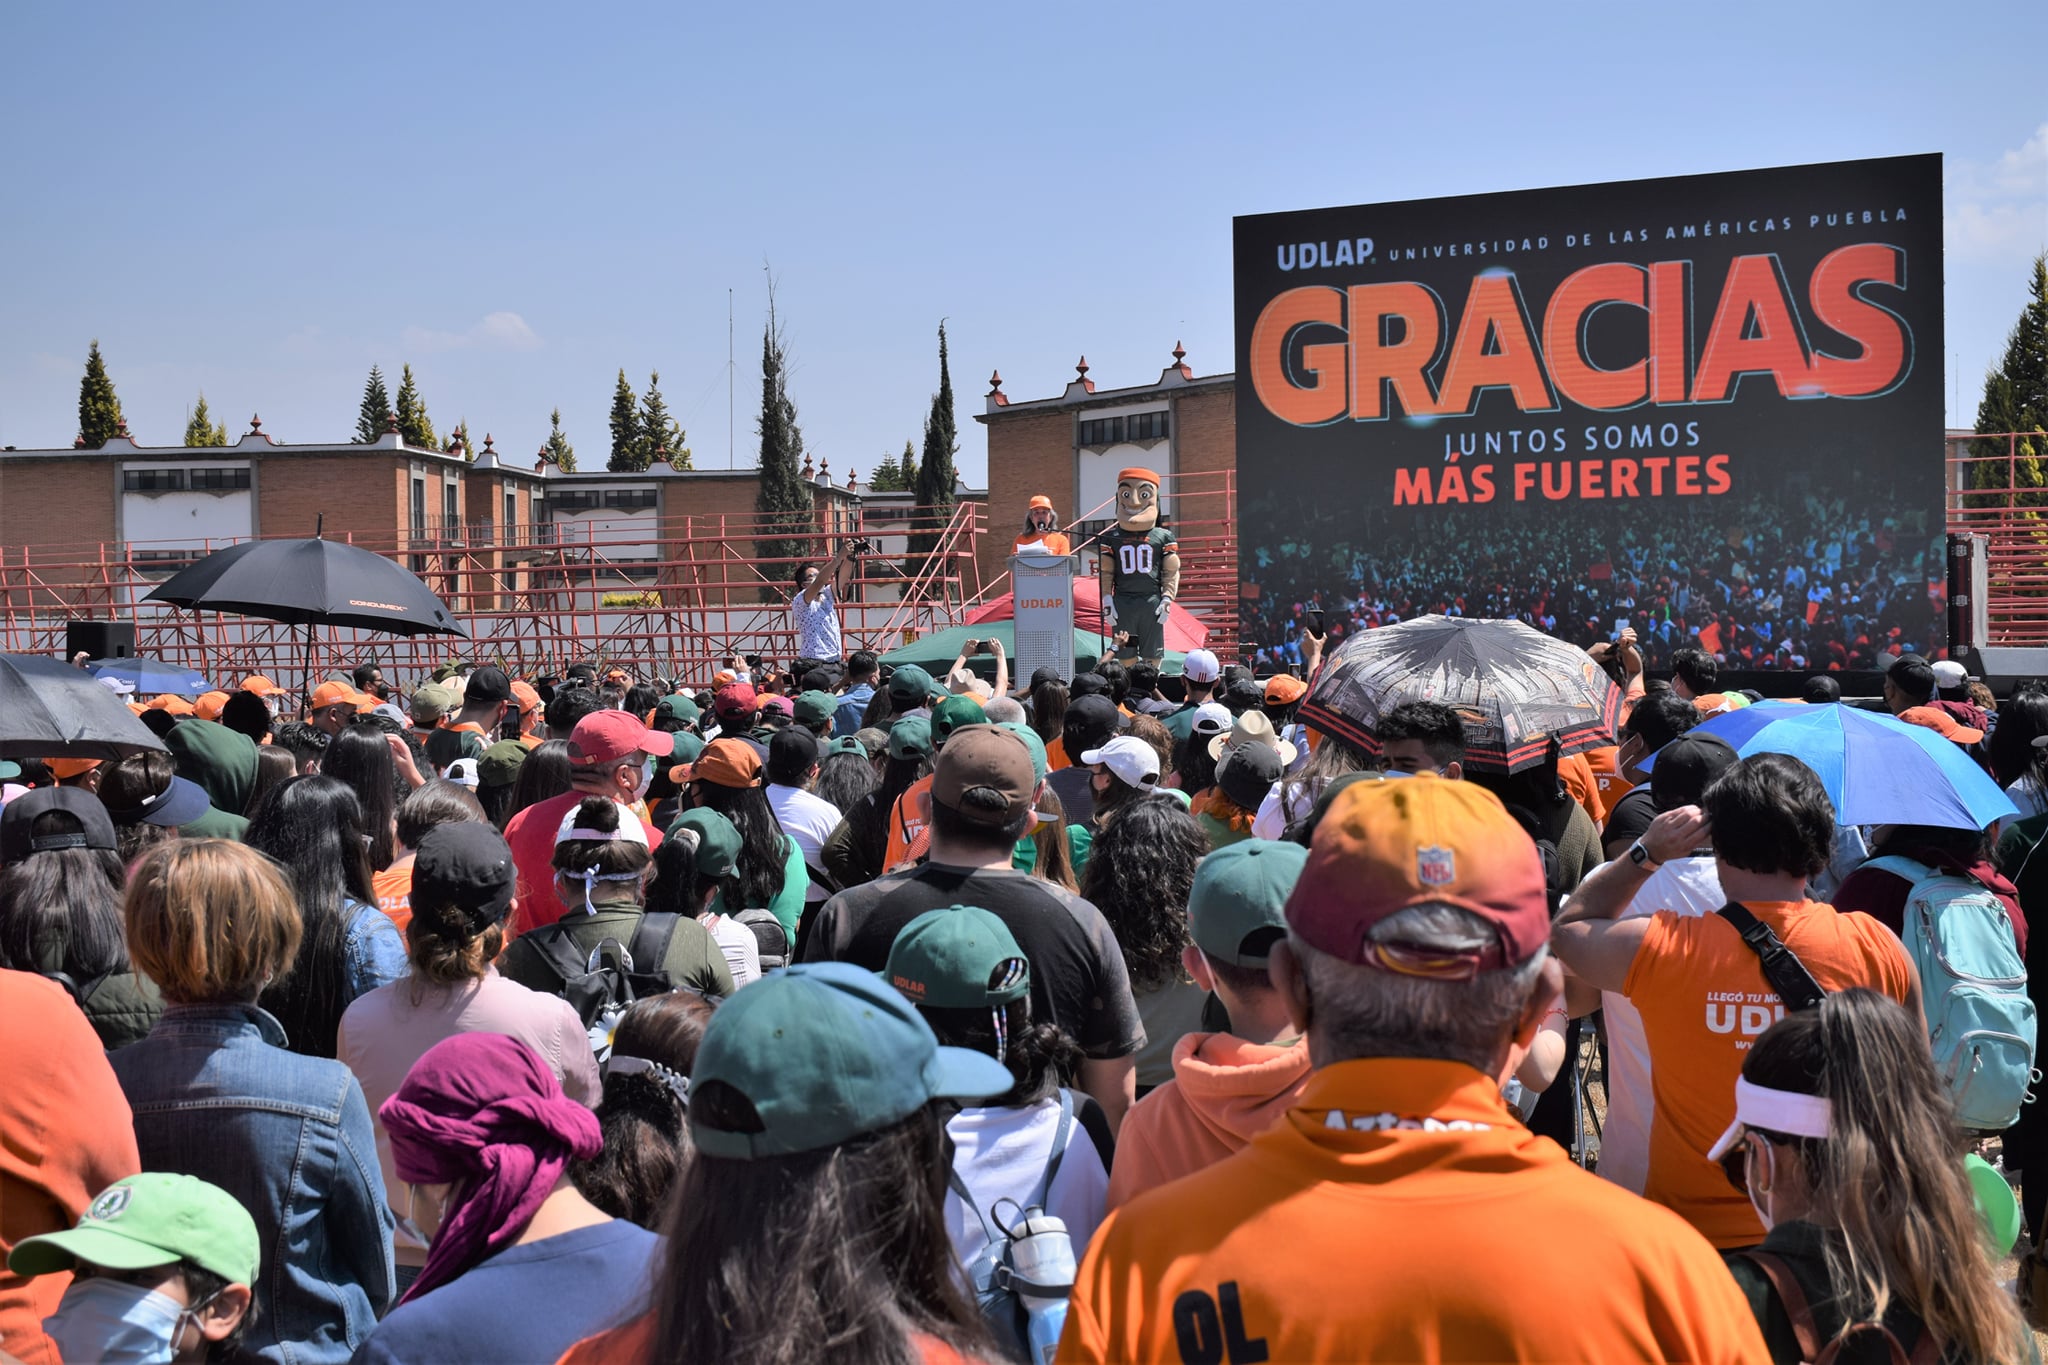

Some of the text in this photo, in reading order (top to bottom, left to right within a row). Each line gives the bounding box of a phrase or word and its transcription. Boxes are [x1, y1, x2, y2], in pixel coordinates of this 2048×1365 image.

[1389, 236, 1549, 261] UNIVERSIDAD
[1566, 233, 1592, 248] DE
[1608, 228, 1649, 244] LAS
[1665, 217, 1792, 240] AMÉRICAS
[1809, 207, 1907, 228] PUEBLA
[1249, 243, 1915, 428] GRACIAS
[1444, 421, 1700, 462] JUNTOS SOMOS
[1392, 452, 1733, 506] MÁS FUERTES
[1119, 544, 1154, 575] 00
[1706, 991, 1745, 1003] LLEGÓ
[1746, 993, 1762, 1003] TU
